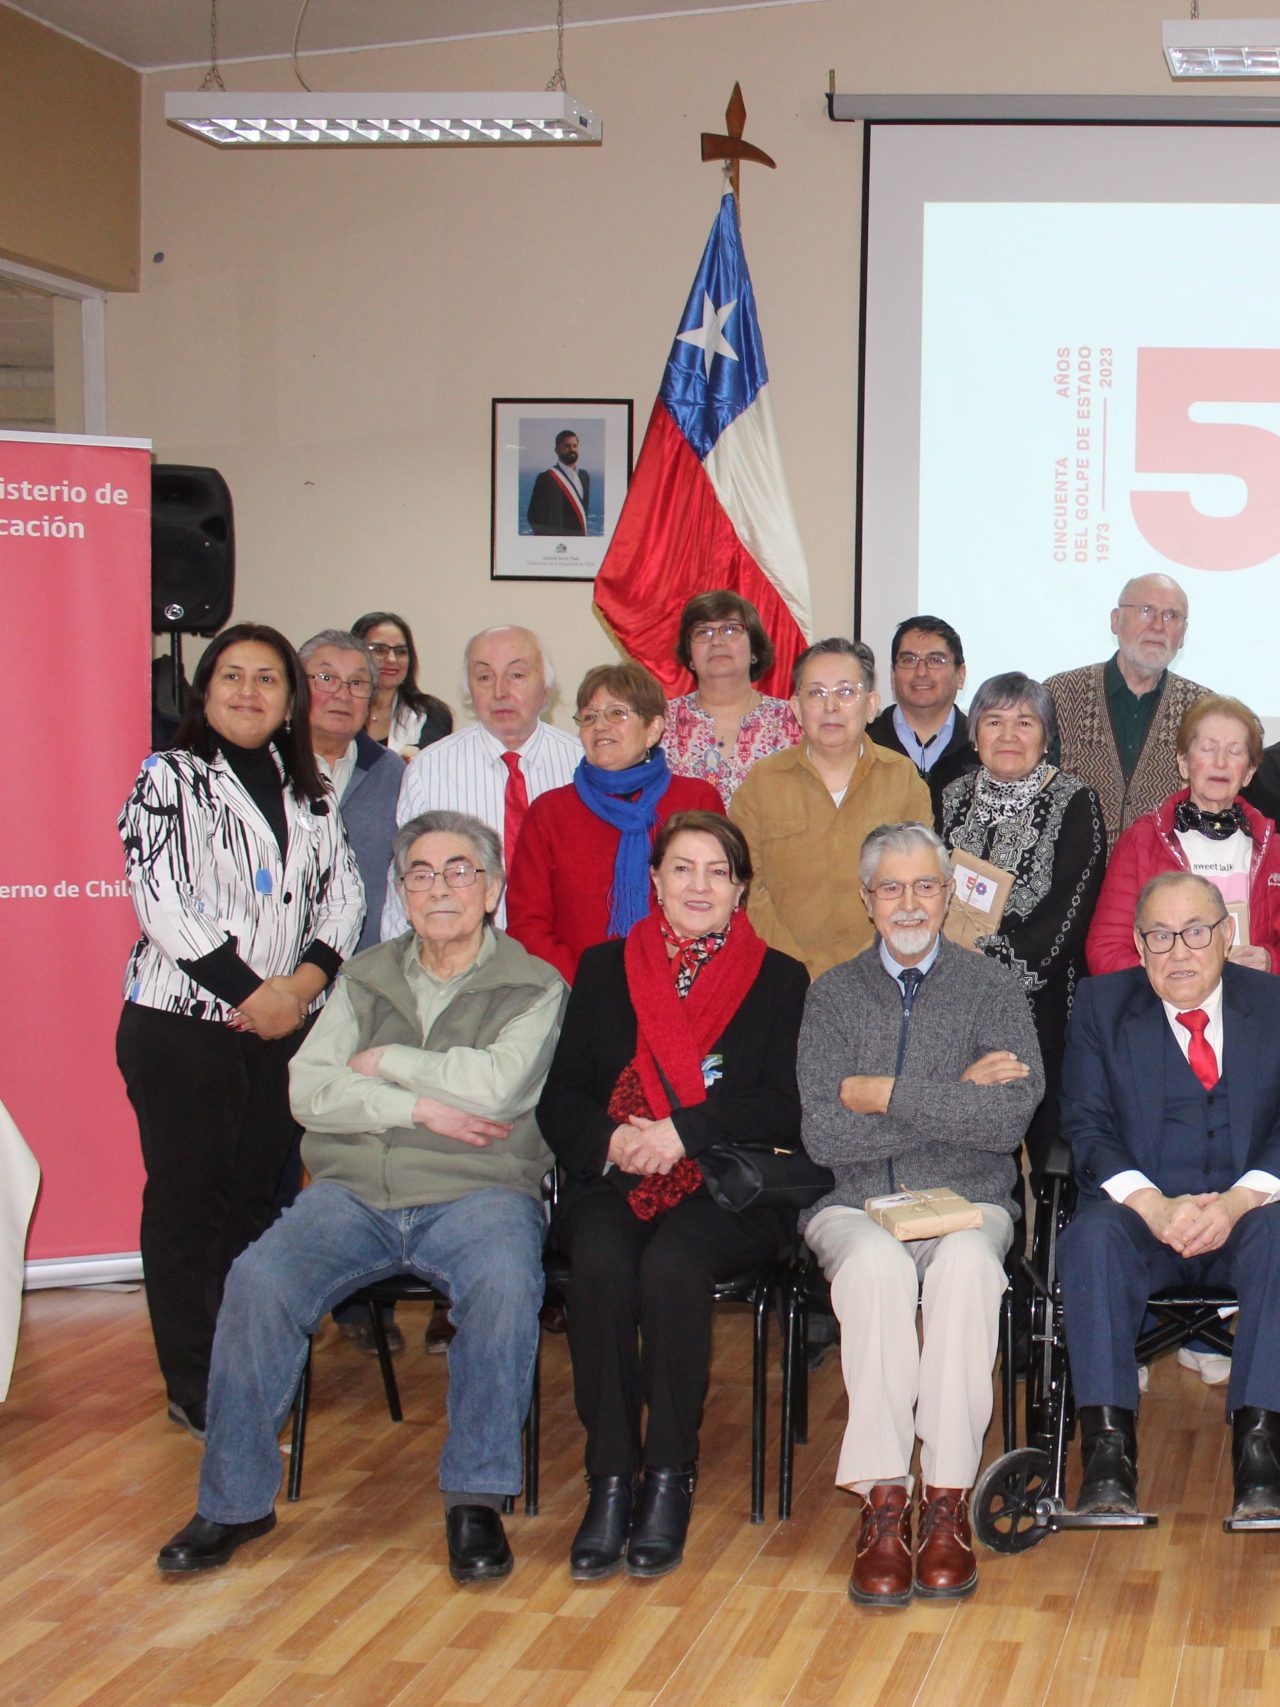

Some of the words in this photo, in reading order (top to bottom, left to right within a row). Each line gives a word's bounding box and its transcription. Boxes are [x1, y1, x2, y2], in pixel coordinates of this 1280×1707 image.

[1053, 346, 1071, 398] AÑOS
[1076, 346, 1093, 420] ESTADO
[1099, 347, 1113, 388] 2023
[1076, 427, 1091, 451] DE
[95, 482, 128, 505] de
[1053, 456, 1069, 563] CINCUENTA
[1075, 457, 1090, 521] GOLPE
[1074, 527, 1088, 563] DEL
[1096, 522, 1110, 563] 1973
[1193, 862, 1219, 871] sweet
[0, 884, 48, 899] erno
[53, 880, 80, 898] de
